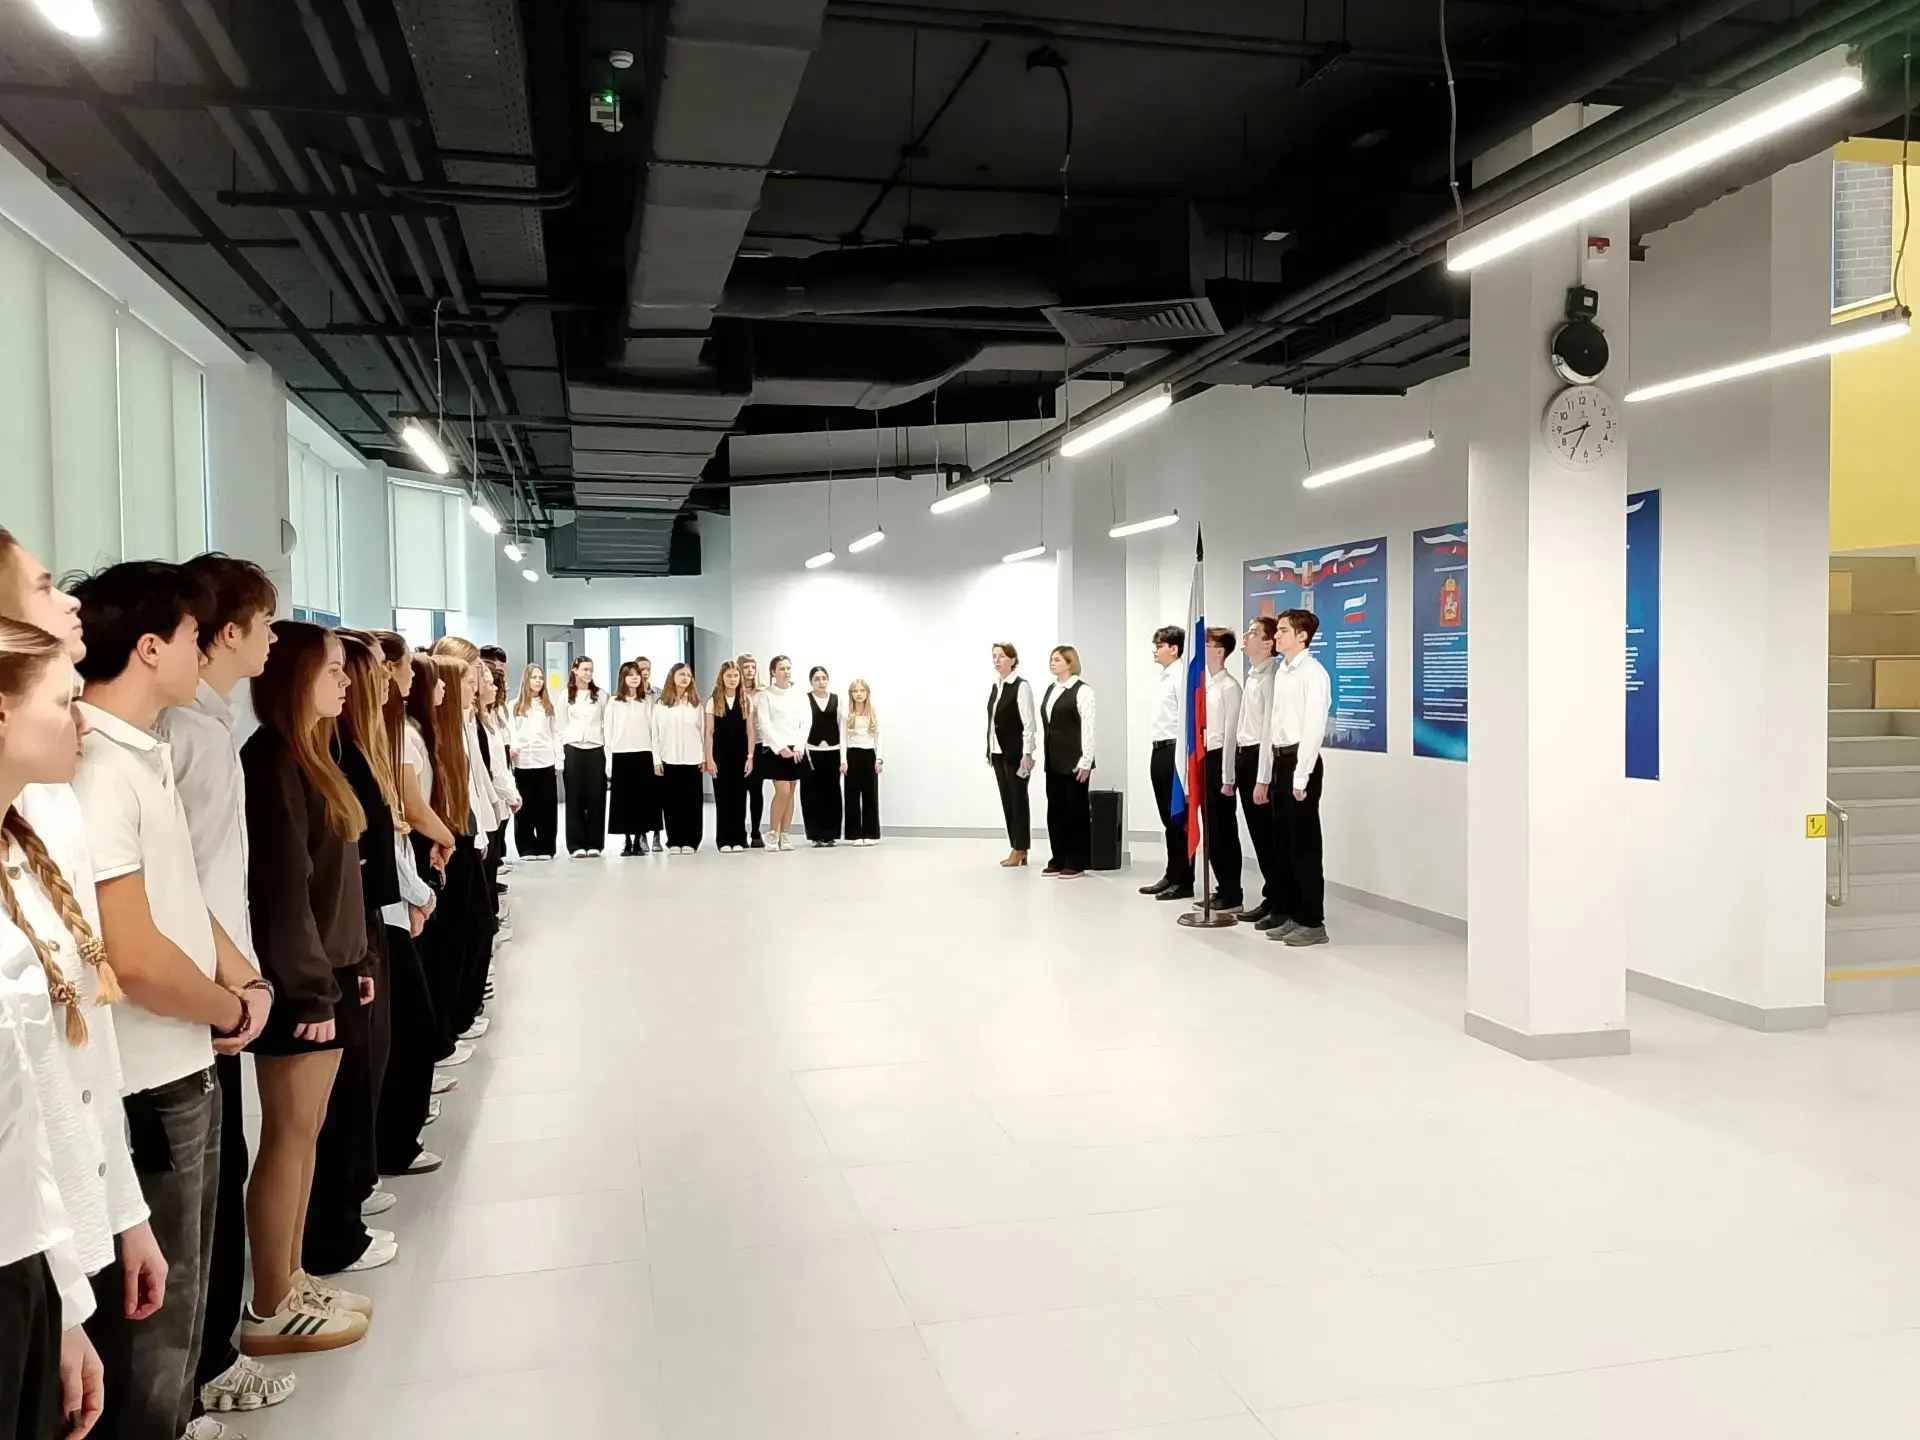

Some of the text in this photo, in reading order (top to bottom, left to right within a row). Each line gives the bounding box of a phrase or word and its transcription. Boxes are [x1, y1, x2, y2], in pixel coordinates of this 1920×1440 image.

[1578, 396, 1586, 405] 12
[1560, 412, 1568, 420] 10
[1601, 408, 1607, 416] 2
[1606, 420, 1611, 429] 3
[1583, 449, 1588, 458] 6
